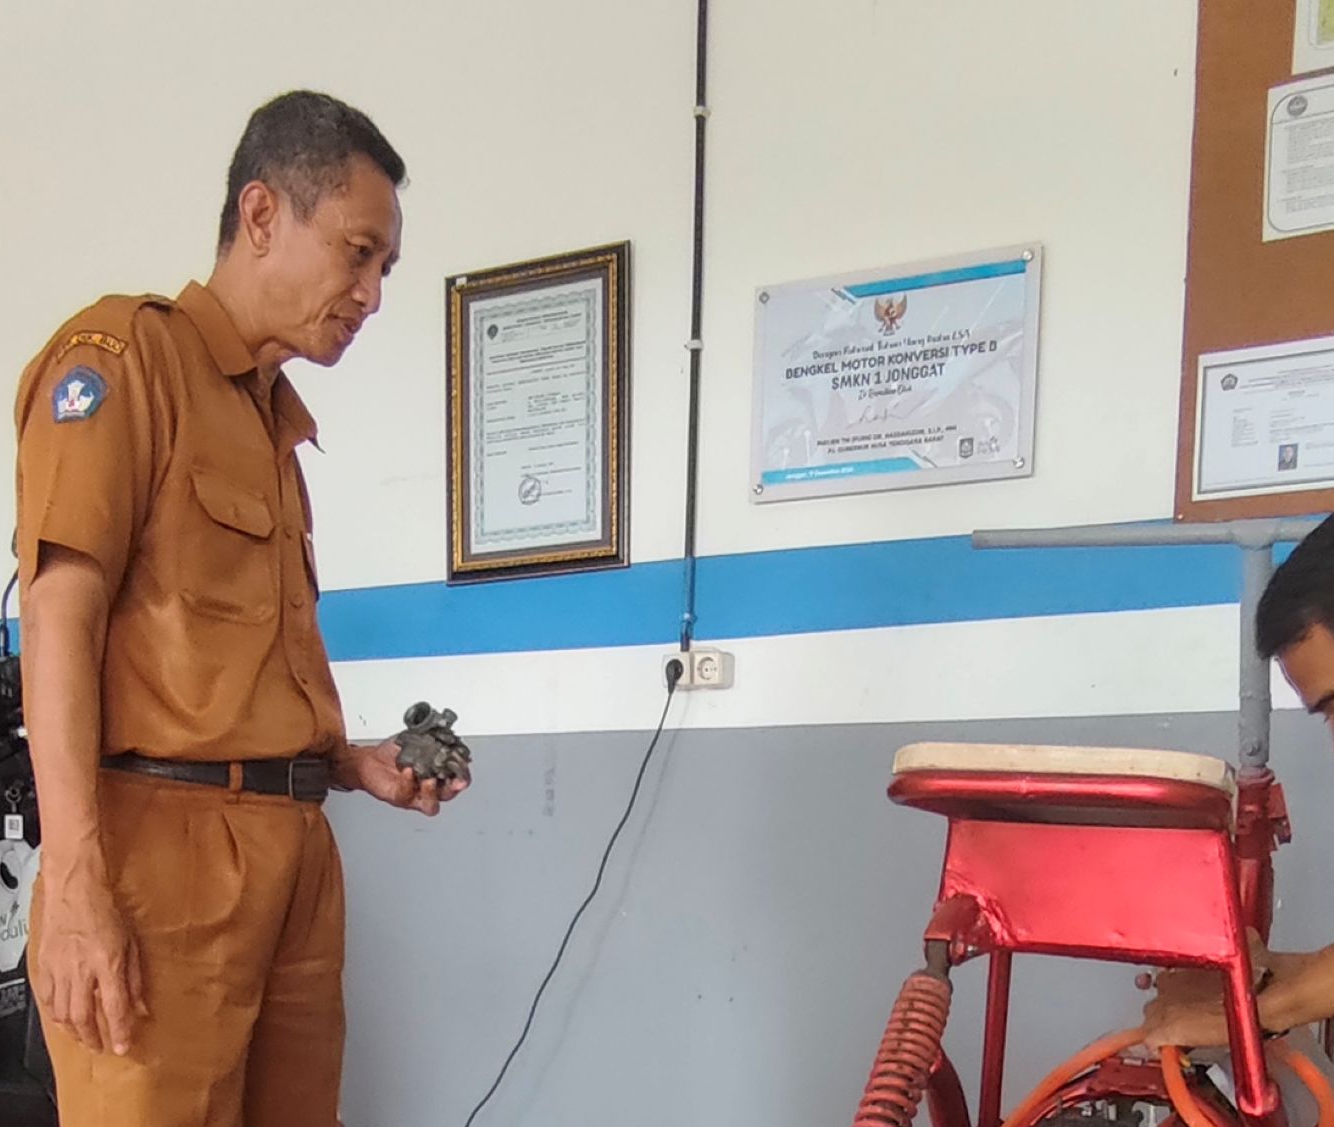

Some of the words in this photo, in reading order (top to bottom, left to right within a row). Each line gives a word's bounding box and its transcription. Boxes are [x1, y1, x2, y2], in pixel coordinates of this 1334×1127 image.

[785, 362, 839, 380] BENGKEL
[841, 355, 885, 372] MOTOR
[887, 346, 949, 365] KONVERSI
[952, 341, 986, 357] TYPE
[831, 372, 871, 391] SMKN
[873, 371, 882, 385] 1
[885, 362, 946, 384] JONGGAT
